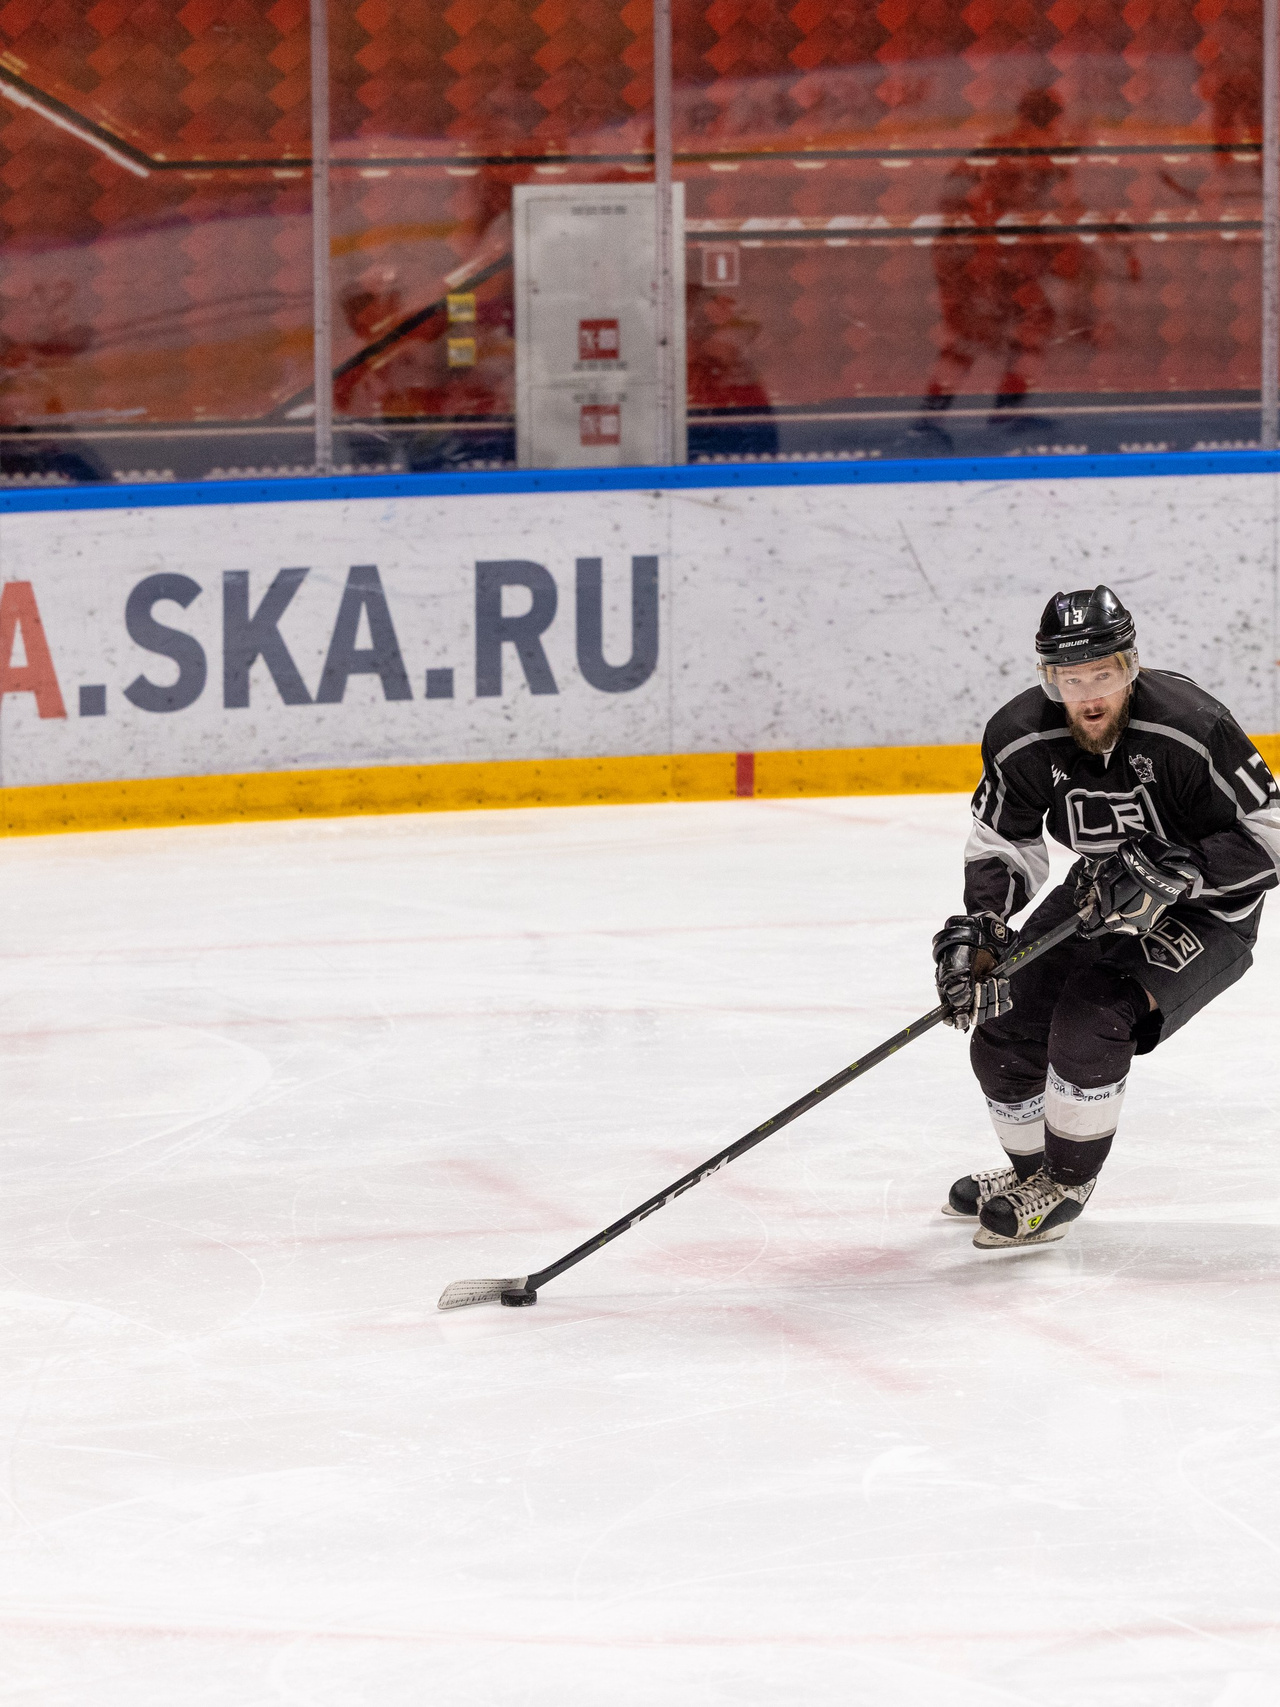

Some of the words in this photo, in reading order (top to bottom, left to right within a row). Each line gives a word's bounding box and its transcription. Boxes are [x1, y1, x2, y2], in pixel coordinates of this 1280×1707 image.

[1064, 608, 1084, 627] 13
[1058, 638, 1090, 650] BAUER
[1073, 801, 1151, 835] LR
[1157, 921, 1197, 959] LR
